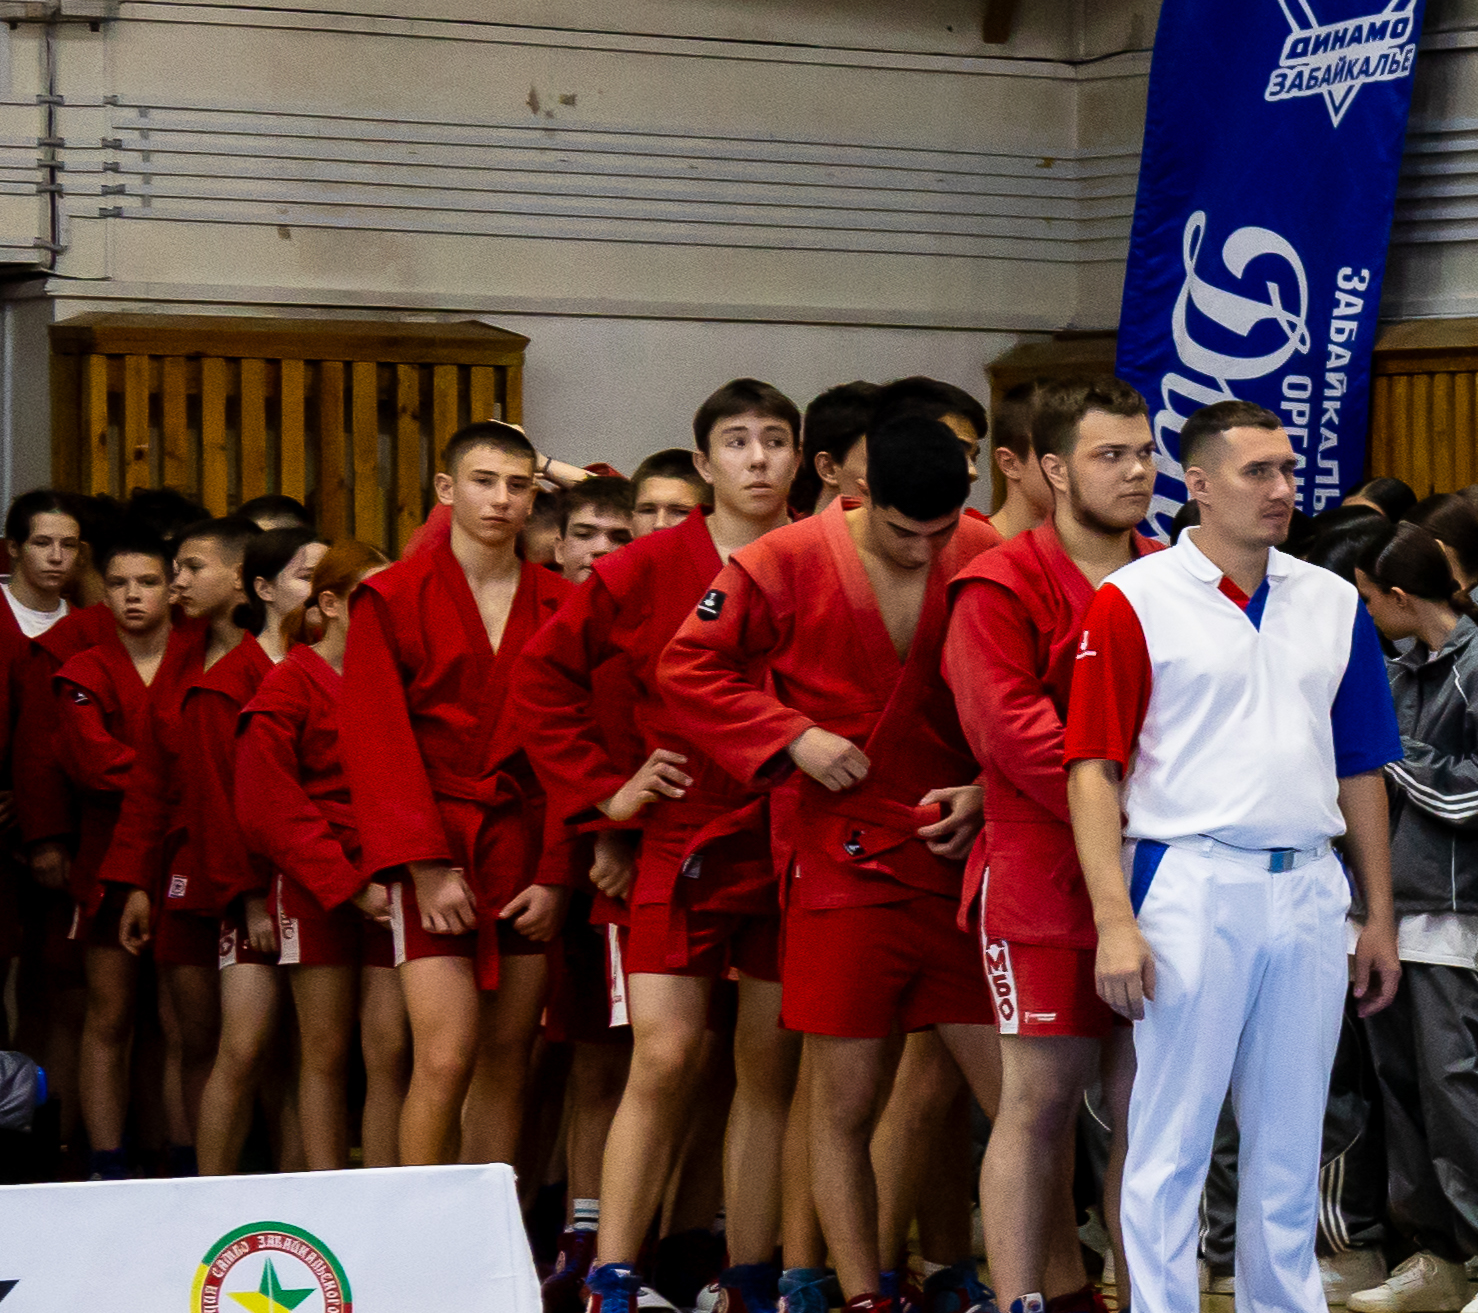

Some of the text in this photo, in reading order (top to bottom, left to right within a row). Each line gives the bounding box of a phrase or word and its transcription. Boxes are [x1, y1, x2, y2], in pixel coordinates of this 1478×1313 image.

[1284, 15, 1411, 61] ДИНАМО
[1269, 45, 1415, 97] ЗАБАЙКАЛЬЕ
[1313, 267, 1370, 517] ЗАБАЙКАЛЬ
